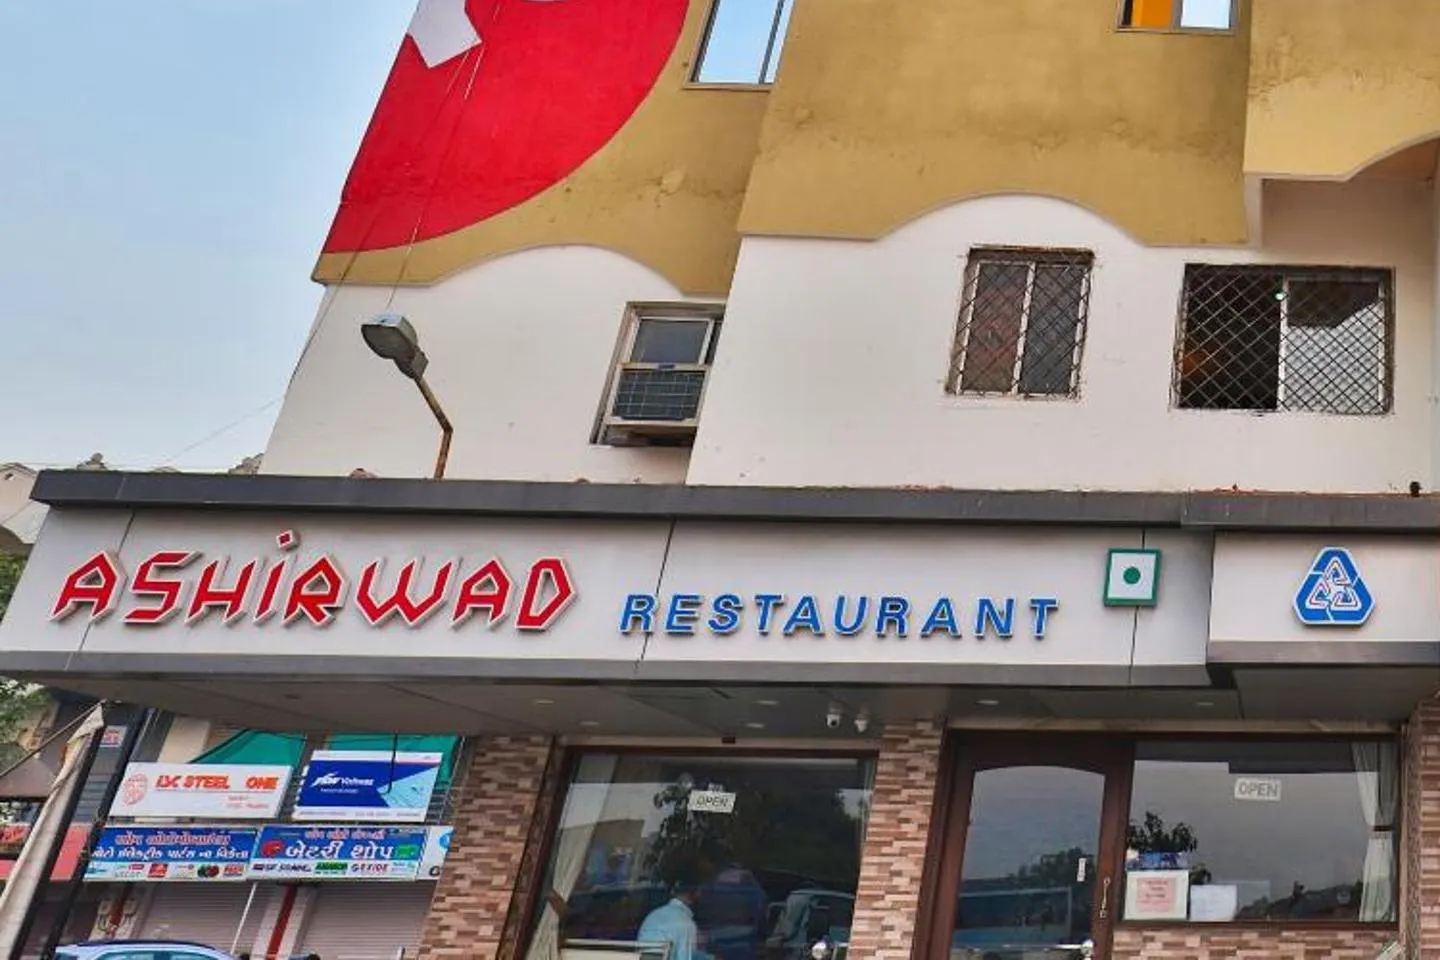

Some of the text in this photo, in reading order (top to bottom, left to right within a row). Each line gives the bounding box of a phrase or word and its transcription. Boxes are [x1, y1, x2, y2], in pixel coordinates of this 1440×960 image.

[619, 593, 1060, 638] RESTAURANT
[182, 775, 231, 790] STEEL
[1238, 781, 1278, 797] OPEN
[285, 840, 394, 859] બેટરી શોપ
